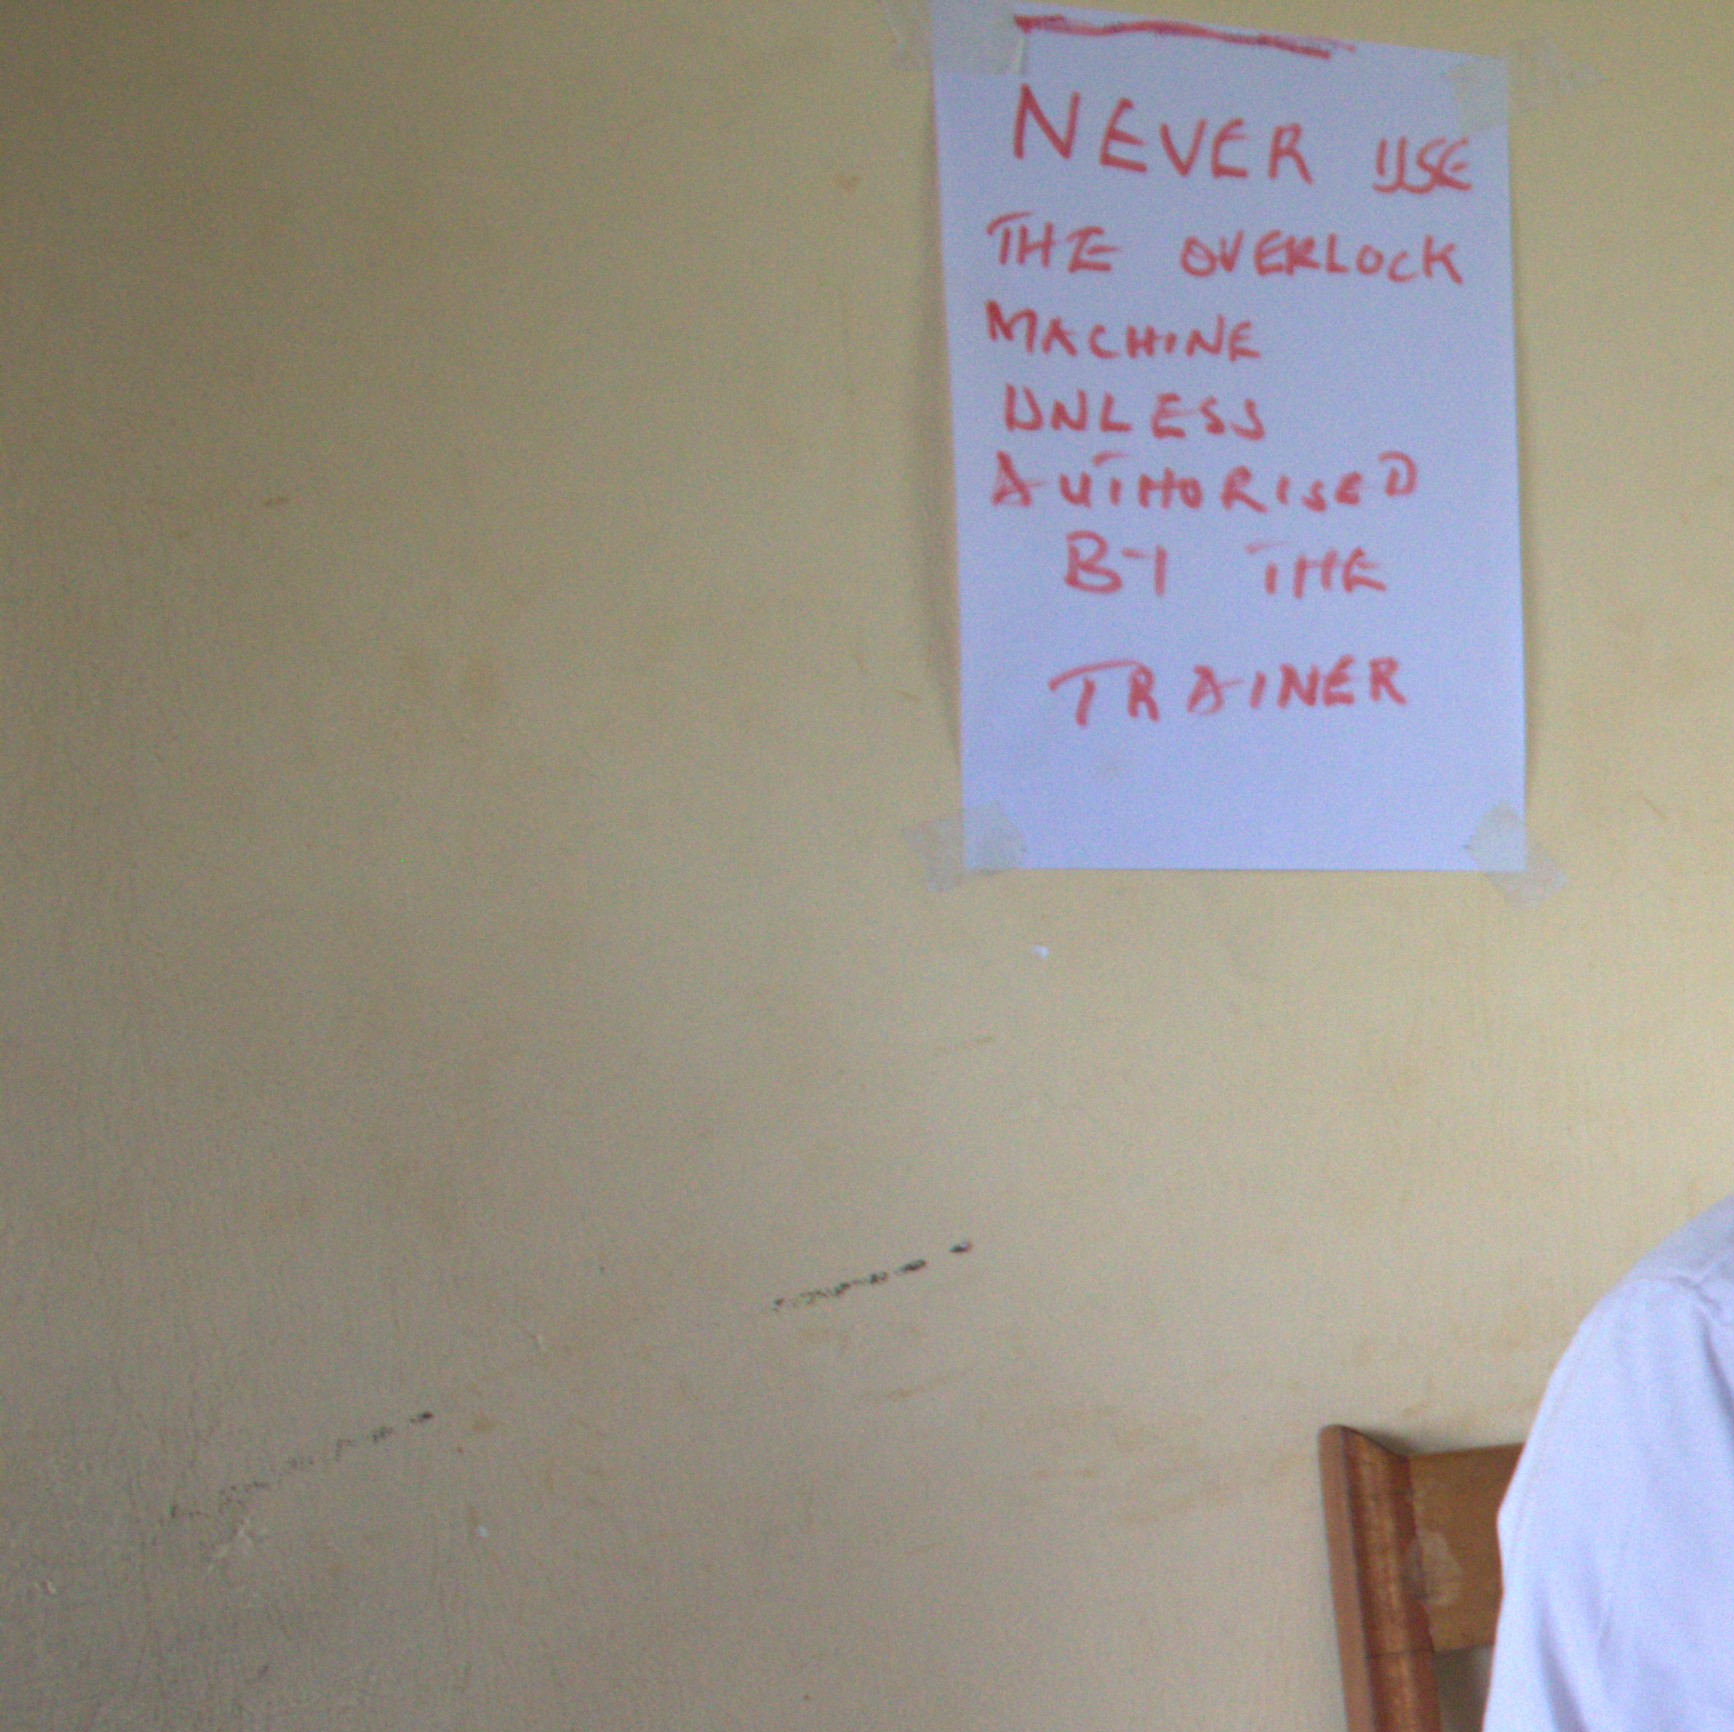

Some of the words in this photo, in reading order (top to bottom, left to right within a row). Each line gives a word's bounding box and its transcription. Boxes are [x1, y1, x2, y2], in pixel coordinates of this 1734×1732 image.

[1013, 83, 1314, 186] NEVER
[1372, 136, 1473, 195] USE
[986, 211, 1121, 274] THE
[1180, 230, 1464, 286] OVERLOCK
[985, 299, 1262, 363] MACHINE
[1003, 382, 1267, 442] UNLESS
[991, 450, 1419, 515] AUTHORISED
[1063, 529, 1169, 597] BY
[1244, 540, 1388, 599] THE
[1047, 654, 1408, 728] TRAINER
